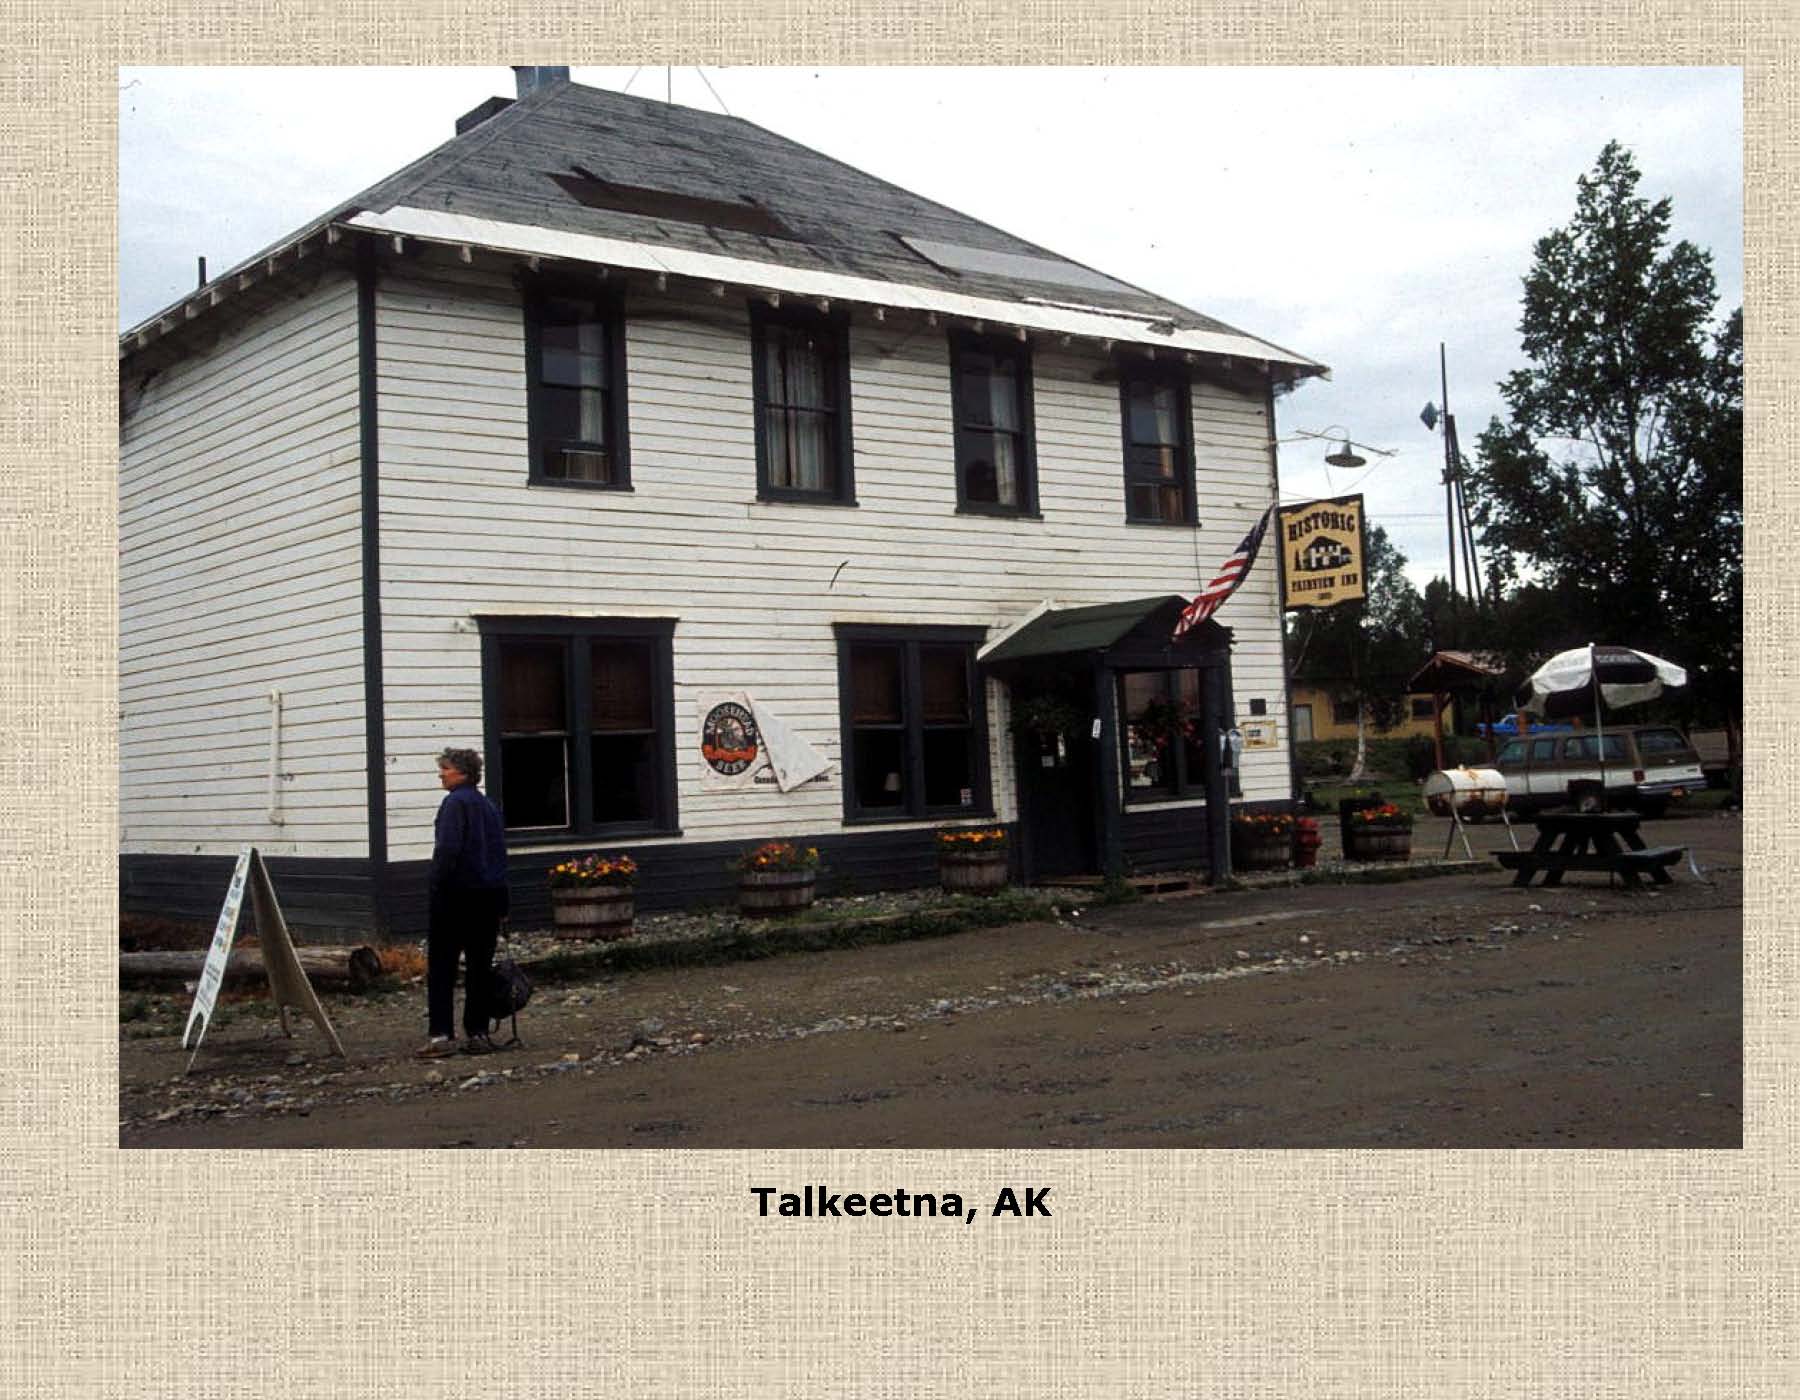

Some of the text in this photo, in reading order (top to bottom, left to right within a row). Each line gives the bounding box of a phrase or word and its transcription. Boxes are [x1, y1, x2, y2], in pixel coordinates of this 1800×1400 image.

[1288, 511, 1355, 541] HISTORIC
[1291, 573, 1358, 592] FAIRVIEW INN
[716, 760, 746, 773] BEER
